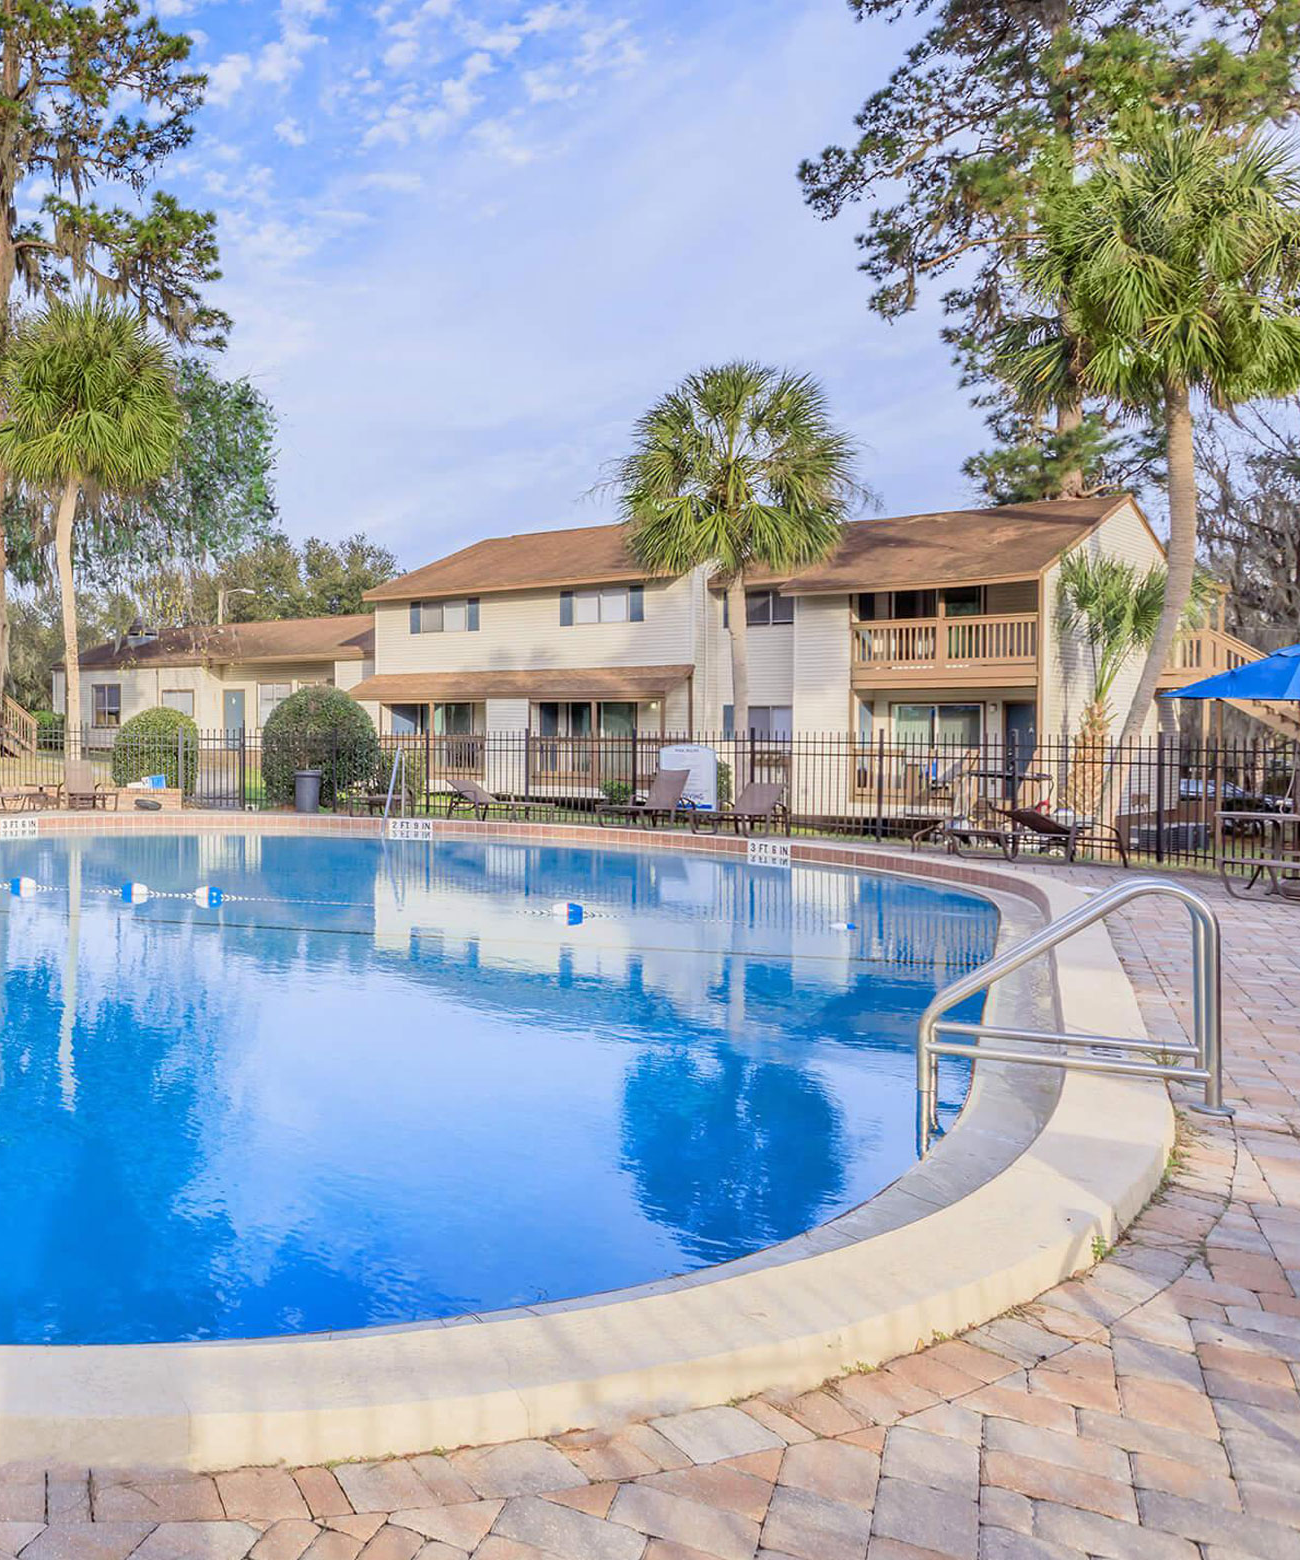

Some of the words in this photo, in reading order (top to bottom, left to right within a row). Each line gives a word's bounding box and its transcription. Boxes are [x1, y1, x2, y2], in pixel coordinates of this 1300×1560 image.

[392, 821, 398, 829] 2
[400, 821, 409, 830] FT
[413, 822, 419, 830] 9
[750, 842, 756, 852] 3
[759, 843, 768, 854] FT
[779, 845, 789, 856] IN
